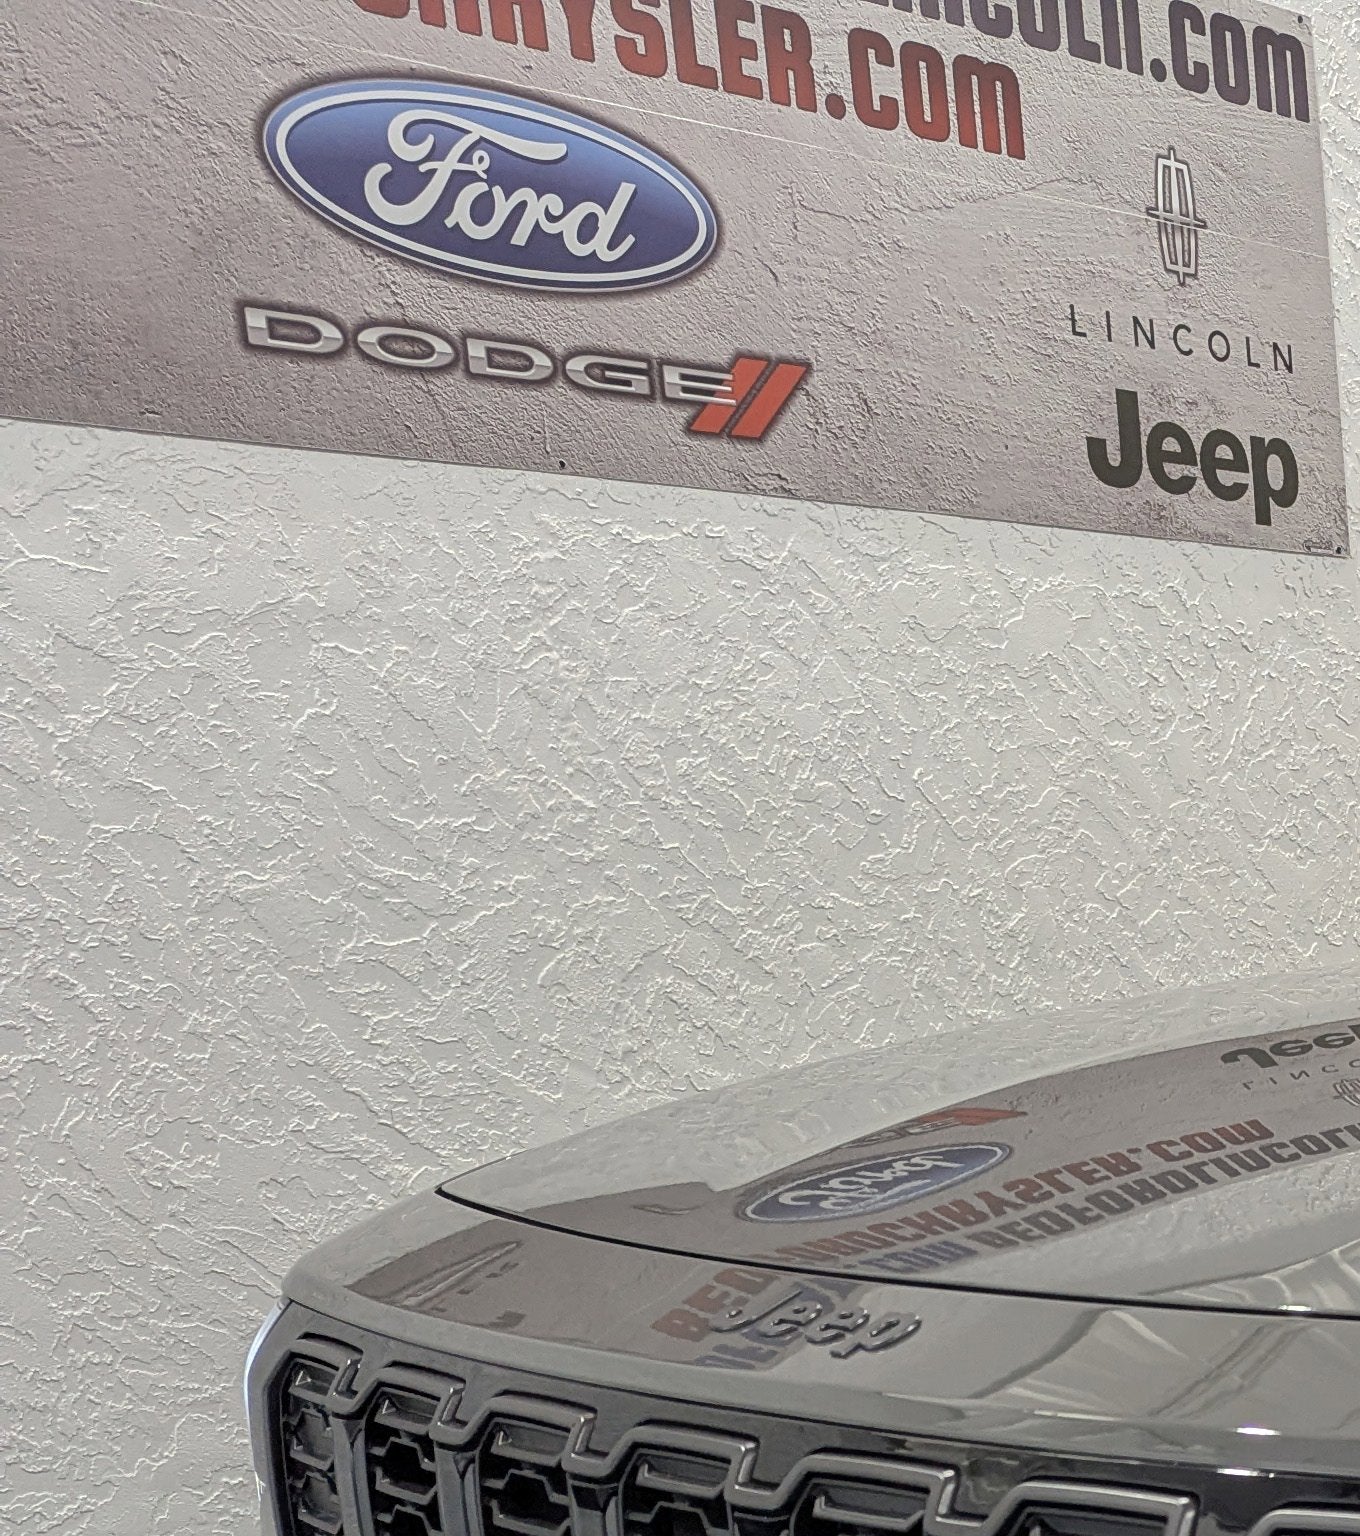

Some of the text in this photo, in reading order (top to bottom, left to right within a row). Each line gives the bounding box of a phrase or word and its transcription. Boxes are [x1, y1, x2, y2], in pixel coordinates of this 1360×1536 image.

[363, 108, 636, 263] Ford
[243, 305, 738, 406] DODGE
[1069, 303, 1294, 374] LINCOLN
[1085, 388, 1299, 527] Jeep
[709, 1287, 922, 1359] Jeep
